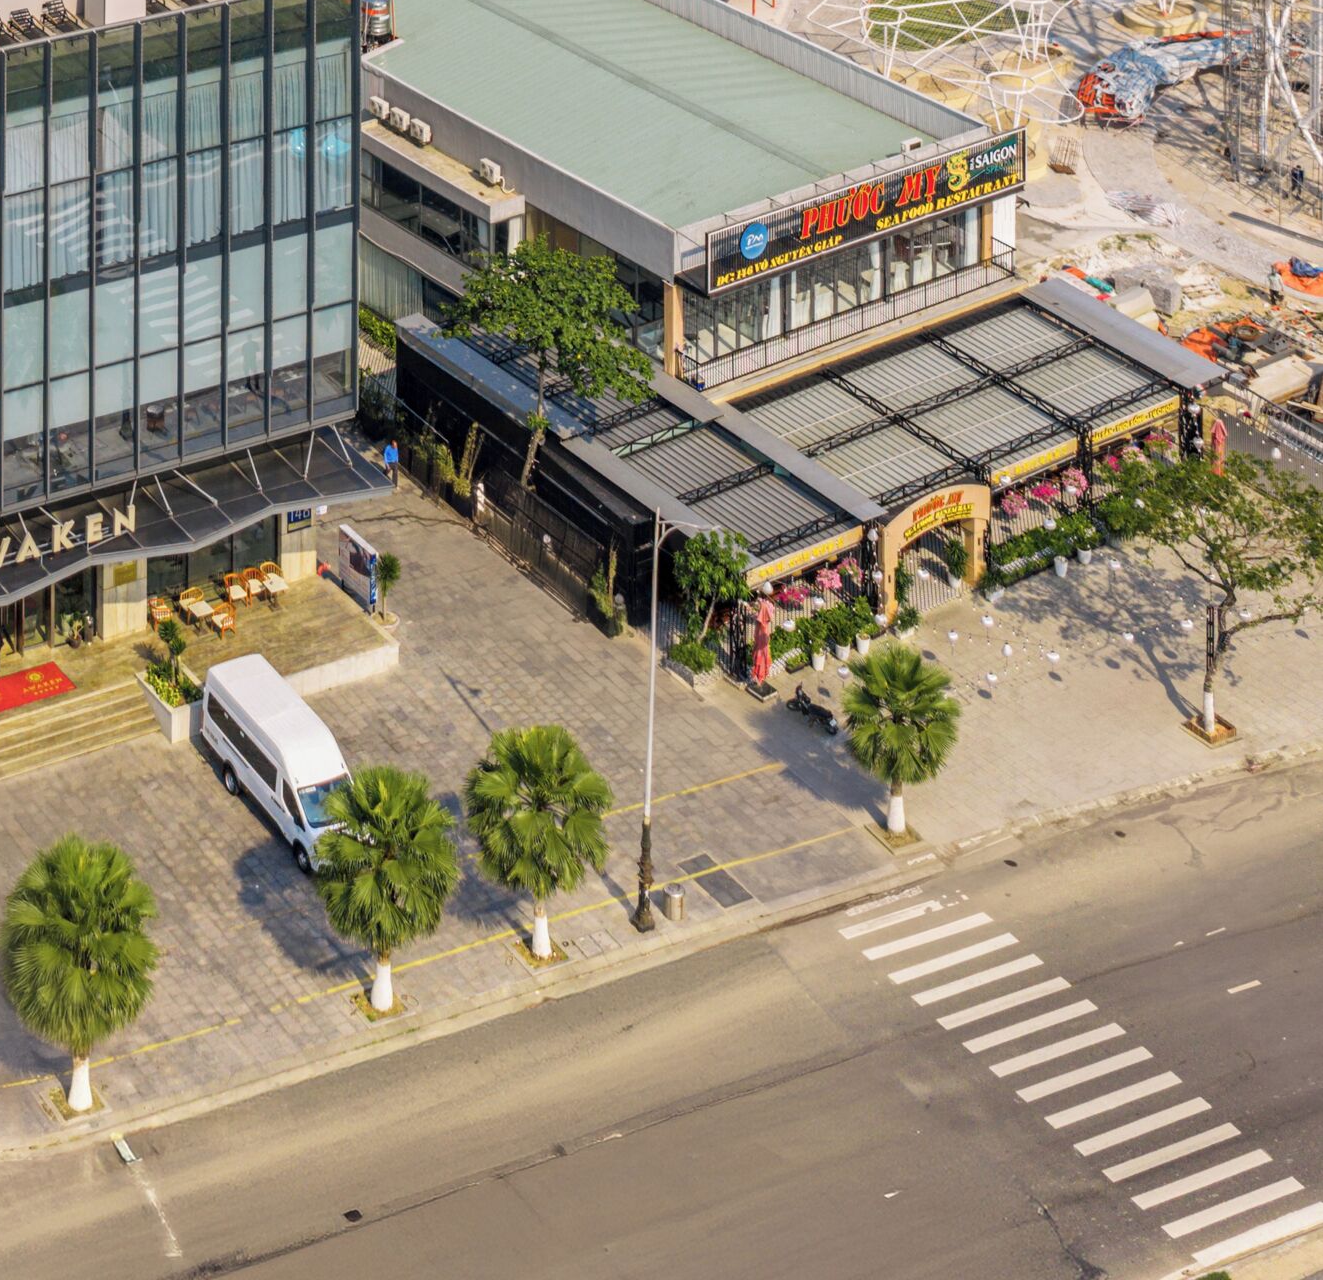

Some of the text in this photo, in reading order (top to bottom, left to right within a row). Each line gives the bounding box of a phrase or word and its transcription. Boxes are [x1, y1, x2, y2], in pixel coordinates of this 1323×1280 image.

[975, 144, 1017, 169] SAIGON
[936, 172, 1019, 211] RESTAURANT
[800, 181, 885, 240] PHƯỚC
[814, 235, 844, 253] GIÁP
